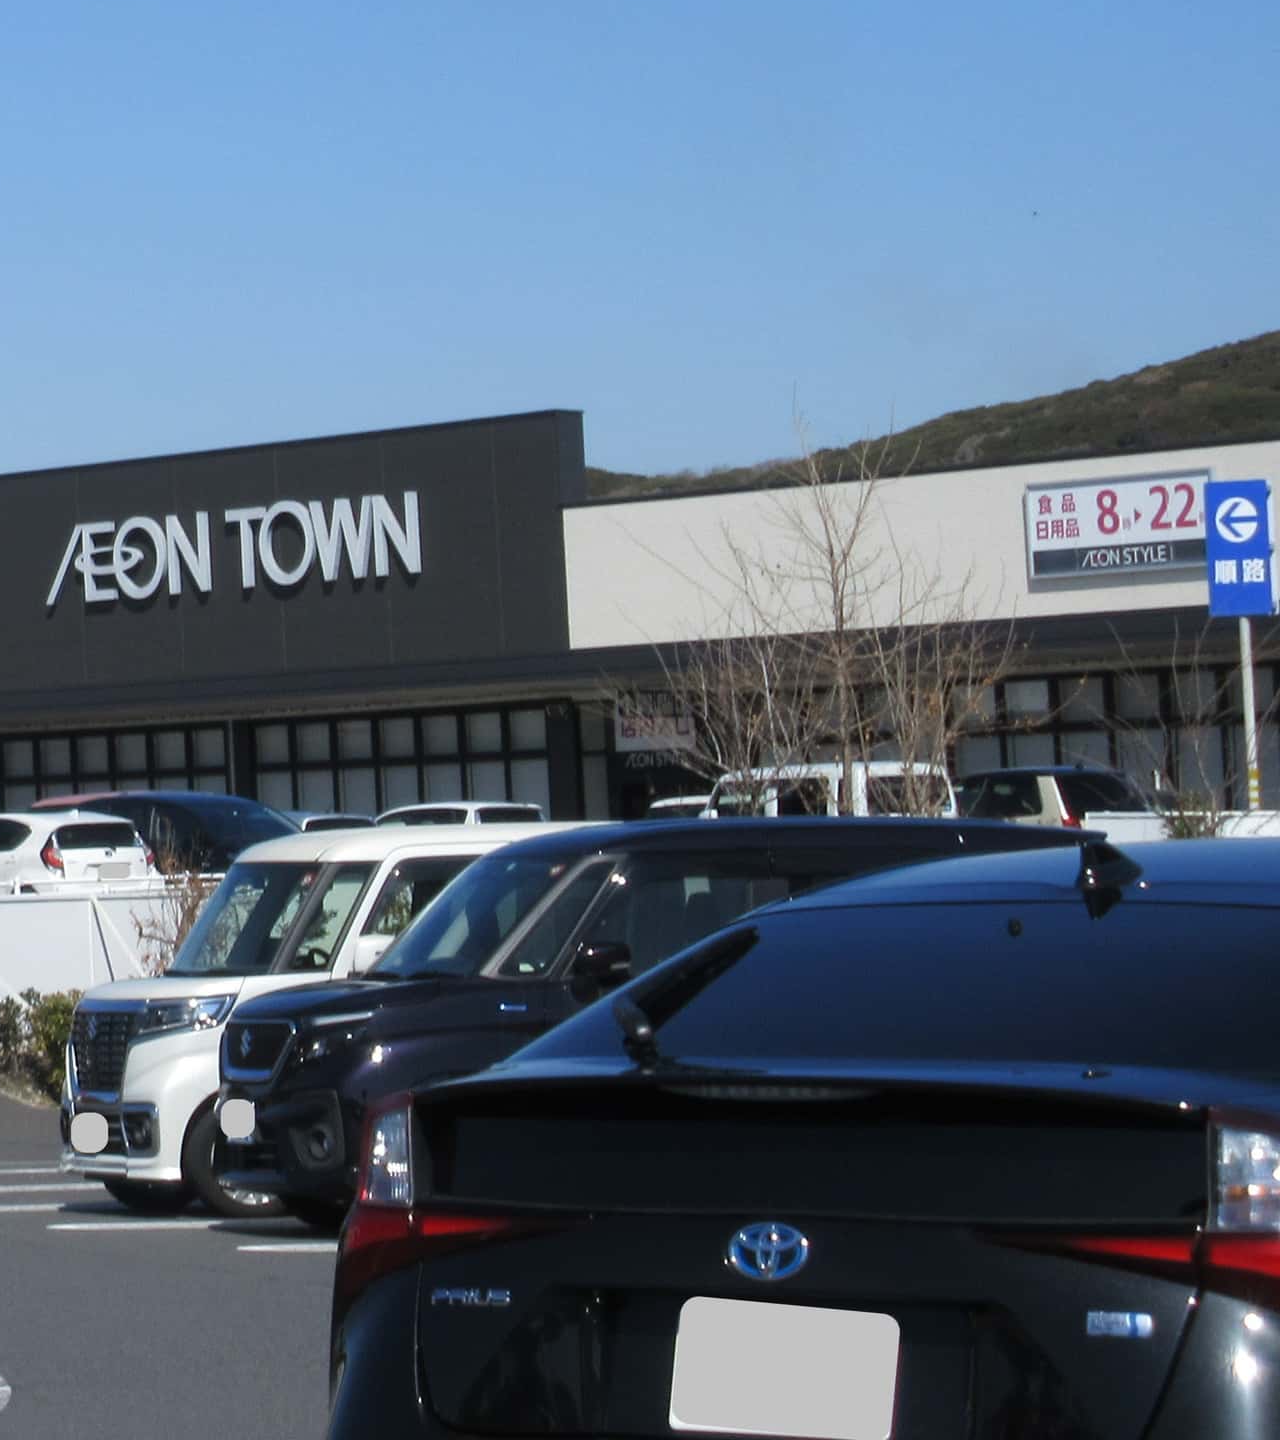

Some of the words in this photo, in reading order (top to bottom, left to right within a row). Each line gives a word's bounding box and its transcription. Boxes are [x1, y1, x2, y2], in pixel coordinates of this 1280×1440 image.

[225, 491, 422, 589] TOWN
[1036, 519, 1080, 540] 日用品
[1124, 544, 1166, 563] STYLE
[1215, 558, 1265, 584] 順路
